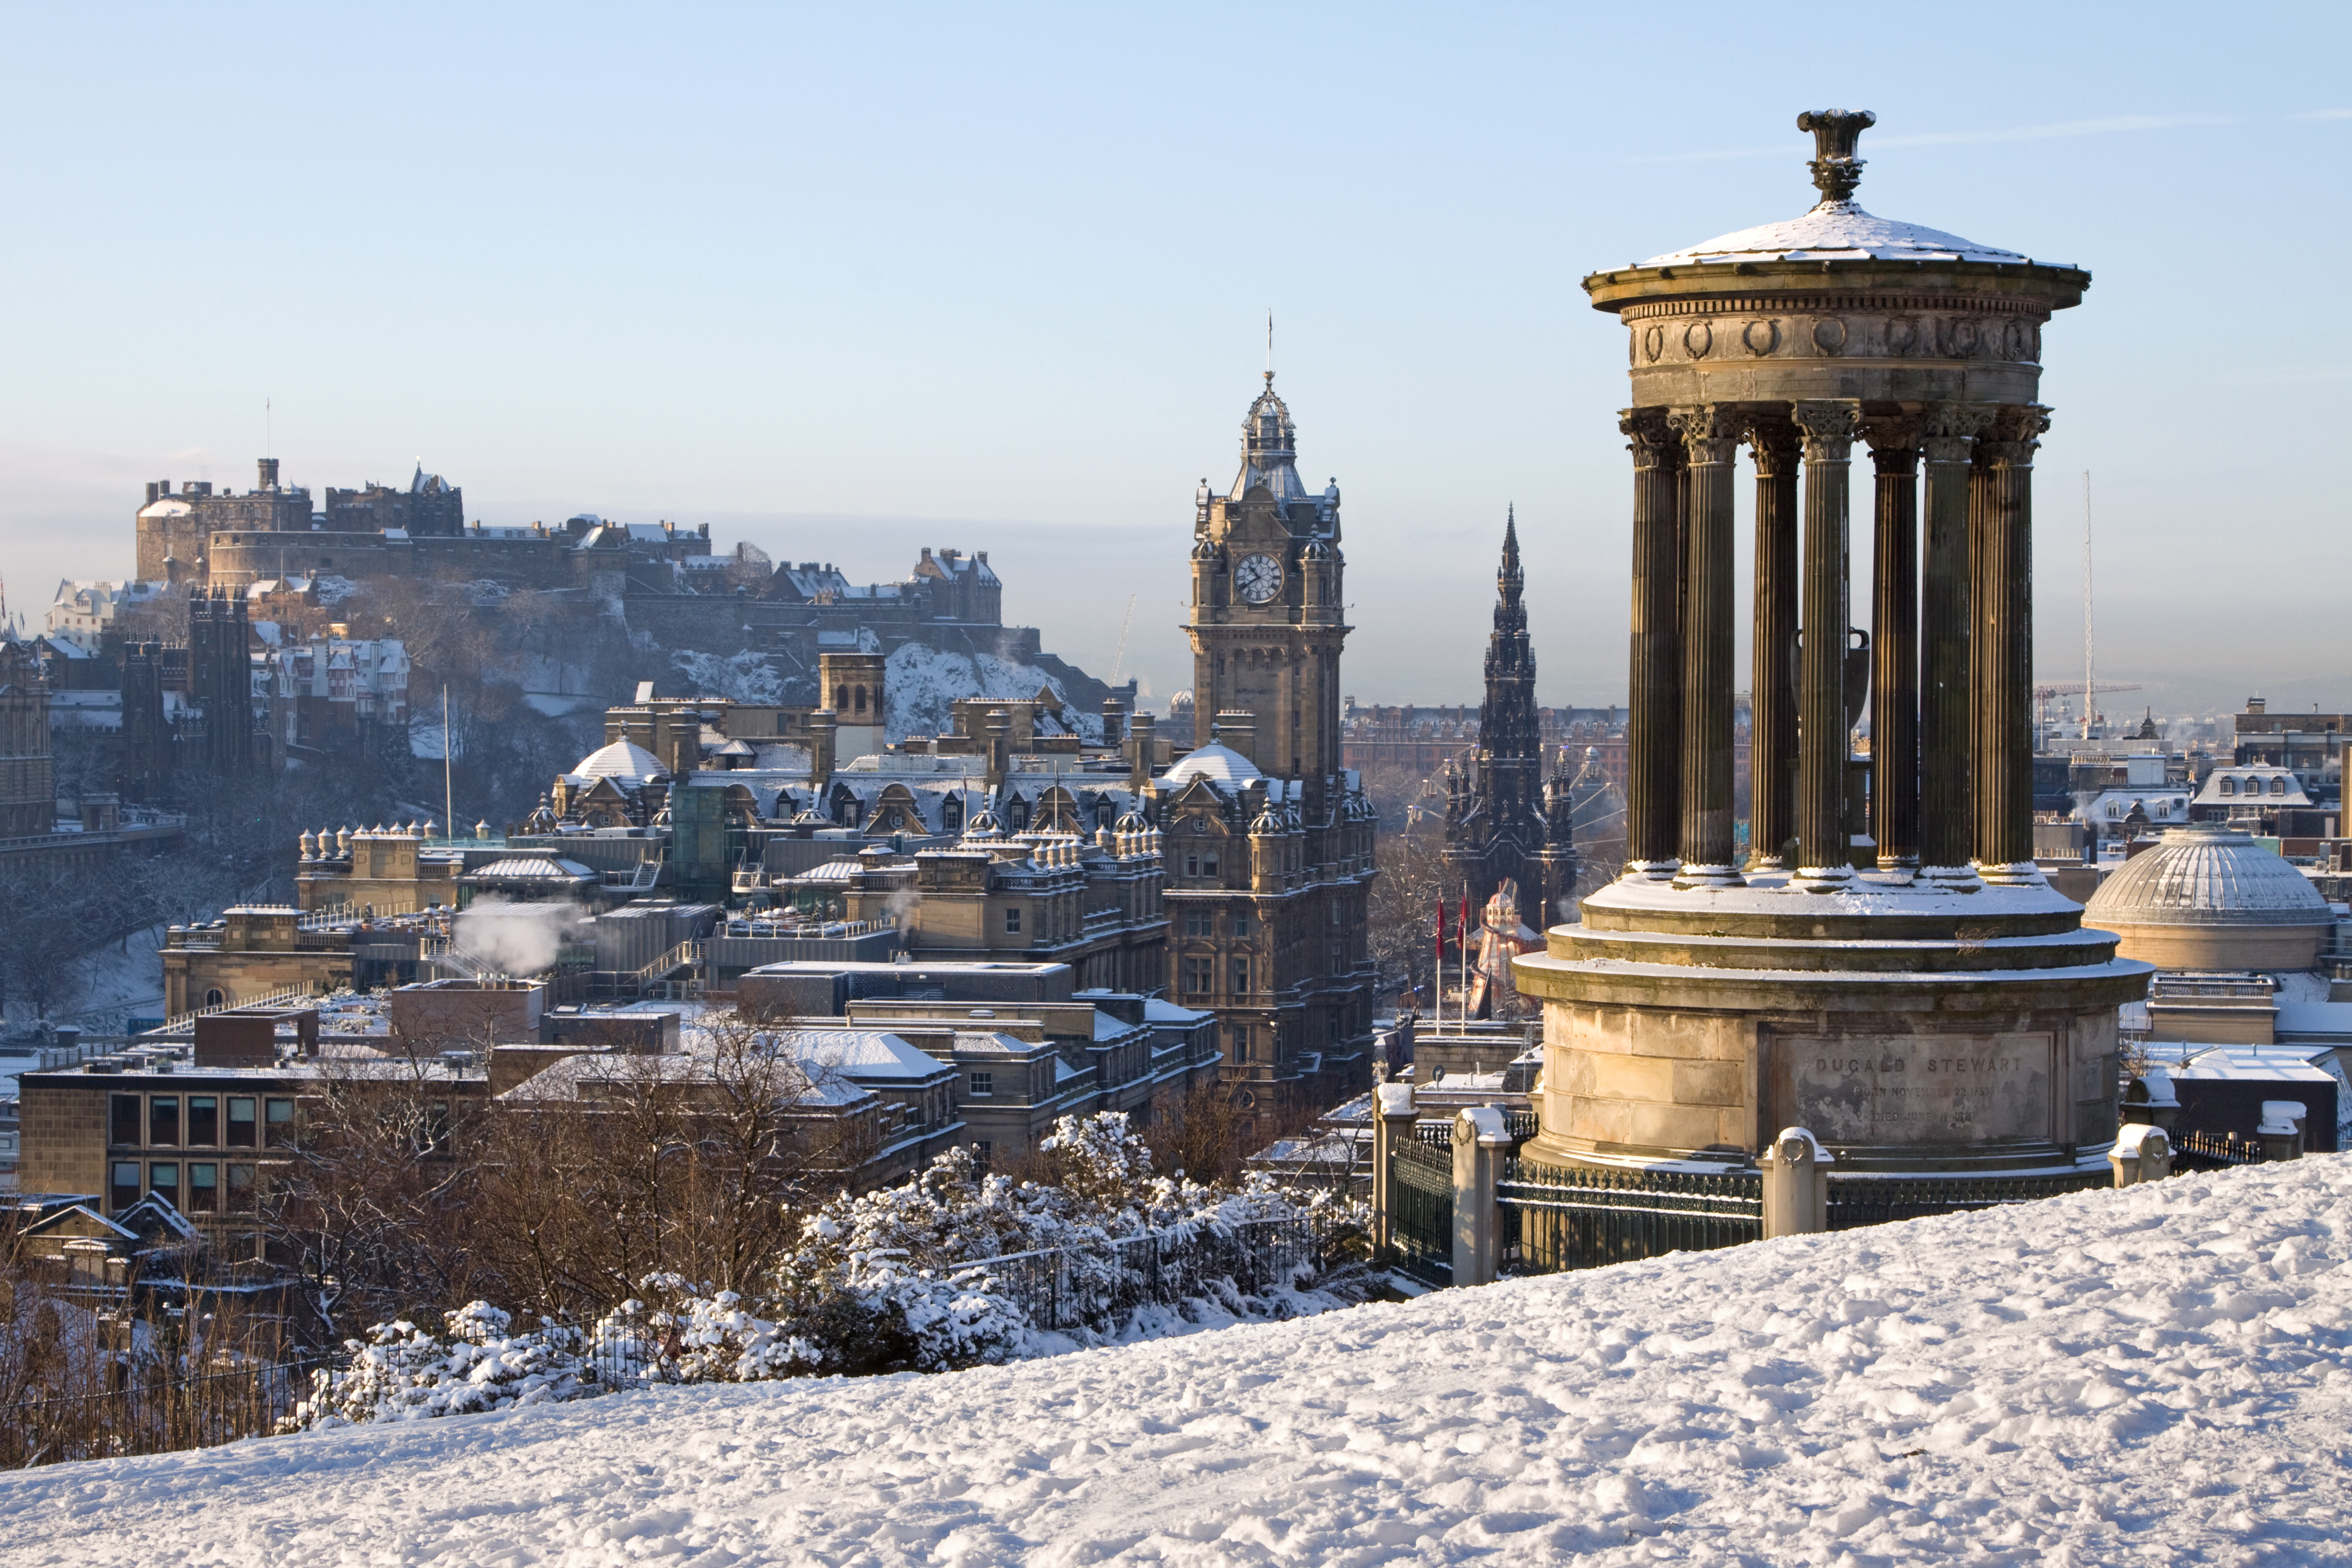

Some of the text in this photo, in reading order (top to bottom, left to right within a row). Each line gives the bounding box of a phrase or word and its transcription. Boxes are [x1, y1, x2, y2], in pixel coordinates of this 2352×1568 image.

[1816, 1057, 2022, 1072] DUGALD STEWART
[1856, 1087, 1887, 1097] BORN
[1891, 1087, 1950, 1097] NOVEMBER
[1955, 1087, 1966, 1096] 22
[1873, 1113, 1900, 1122] DIED
[1904, 1112, 1932, 1122] JUNE
